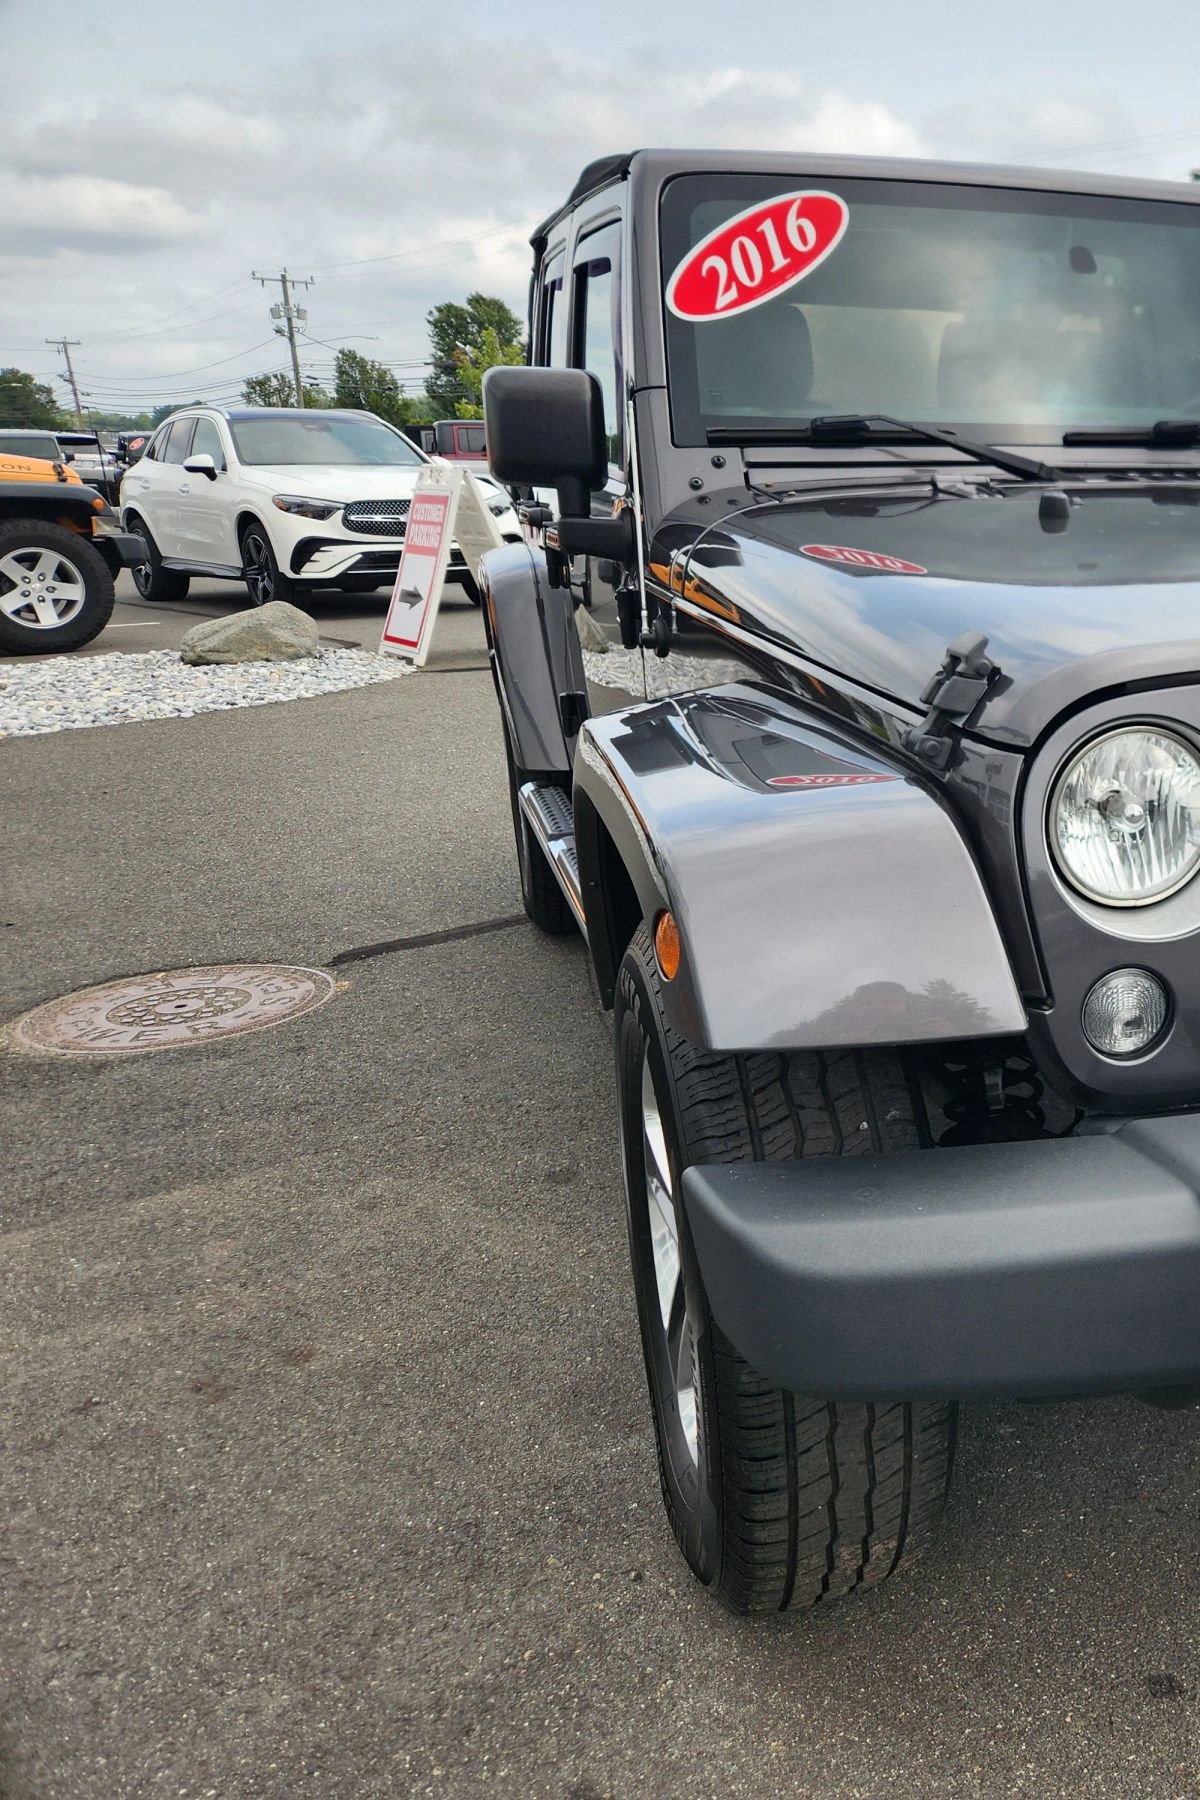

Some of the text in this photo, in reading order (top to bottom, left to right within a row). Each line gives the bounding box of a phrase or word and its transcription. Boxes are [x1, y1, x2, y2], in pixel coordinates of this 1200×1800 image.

[701, 197, 817, 311] 2016
[412, 503, 445, 522] CUSTOMER
[408, 523, 442, 549] PARKING
